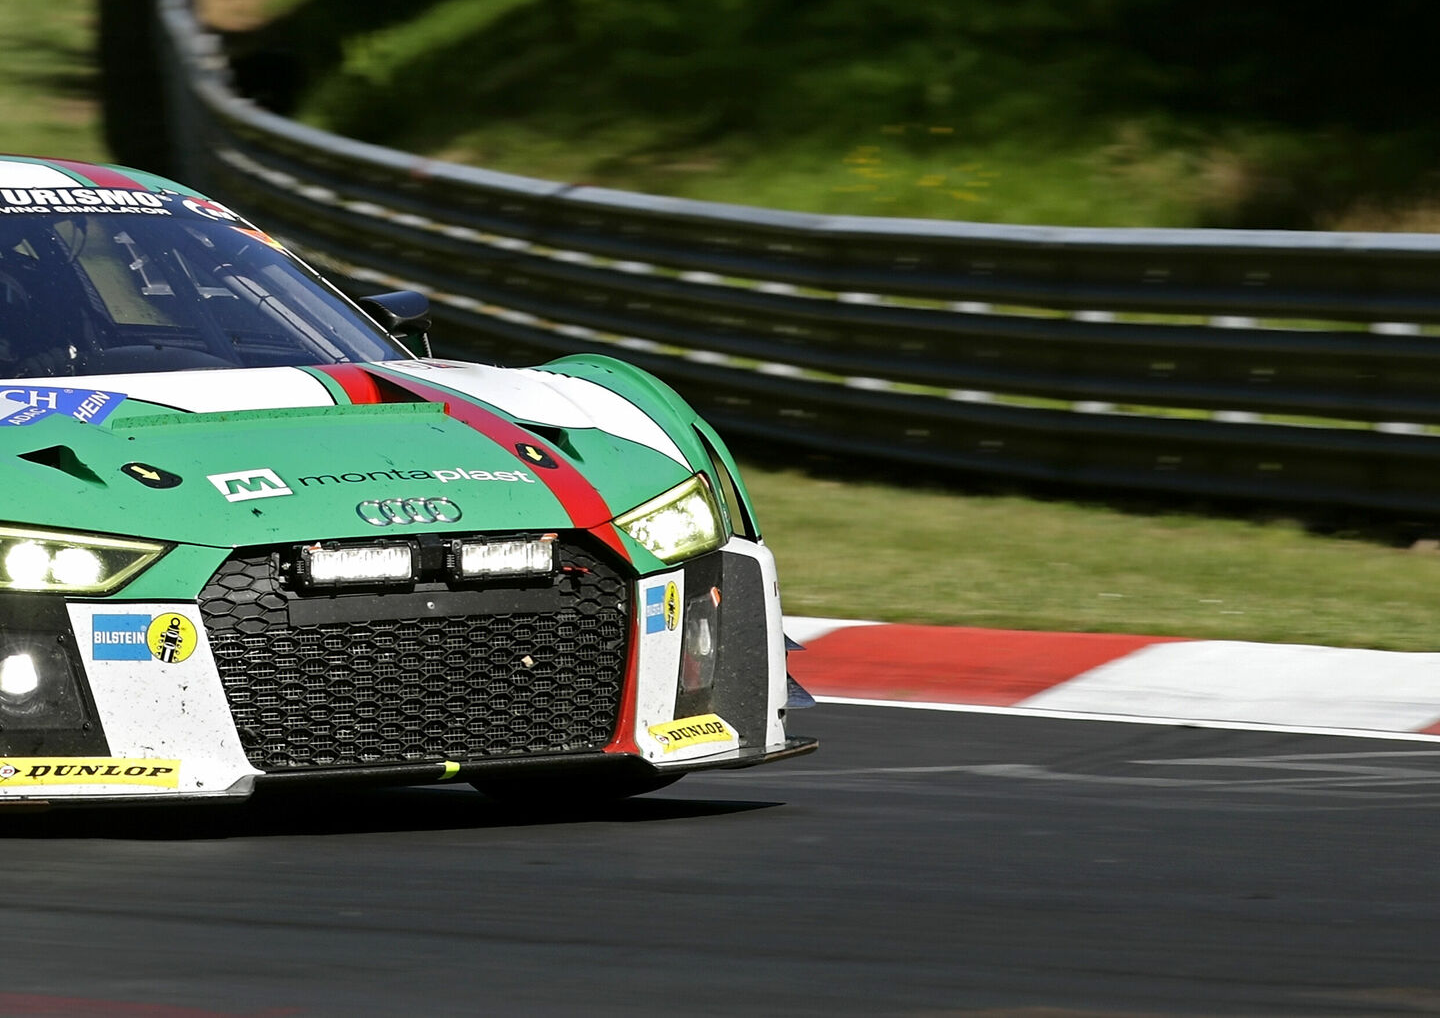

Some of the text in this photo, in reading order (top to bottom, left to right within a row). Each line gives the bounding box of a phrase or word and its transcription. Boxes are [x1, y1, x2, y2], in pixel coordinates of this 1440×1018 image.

[53, 206, 173, 216] SIMULATOR
[7, 407, 47, 425] ADAC
[72, 390, 111, 424] HEIN
[297, 467, 536, 487] montaplast
[93, 630, 146, 645] BILSTEIN
[668, 720, 726, 742] DUNLOP
[25, 765, 173, 778] DUNLOP
